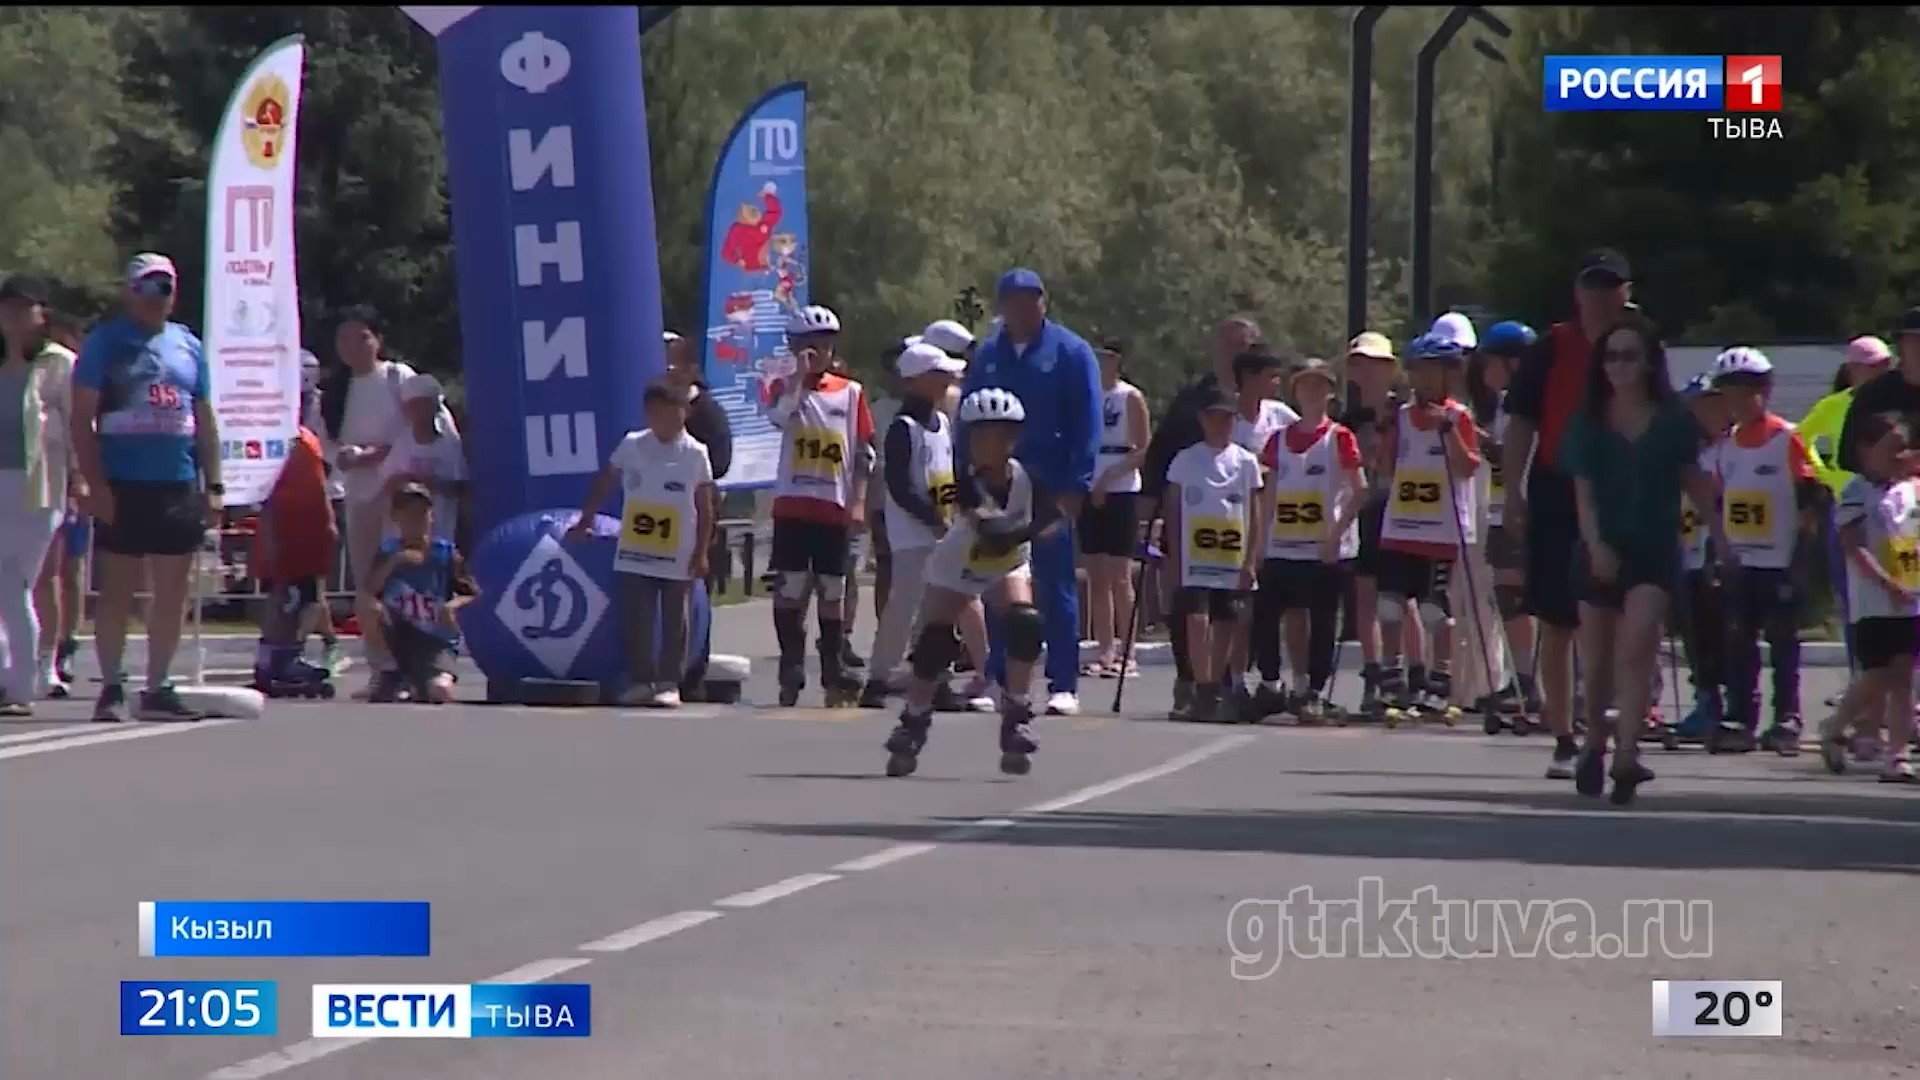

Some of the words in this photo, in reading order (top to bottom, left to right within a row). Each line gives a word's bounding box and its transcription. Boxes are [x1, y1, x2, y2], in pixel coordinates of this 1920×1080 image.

[749, 118, 798, 161] ГТО
[500, 31, 599, 477] ФИНИШ
[149, 384, 178, 407] 95
[794, 437, 843, 464] 114
[1278, 502, 1323, 524] 53
[1730, 502, 1766, 525] 51
[633, 512, 671, 540] 91
[1194, 527, 1242, 551] 62
